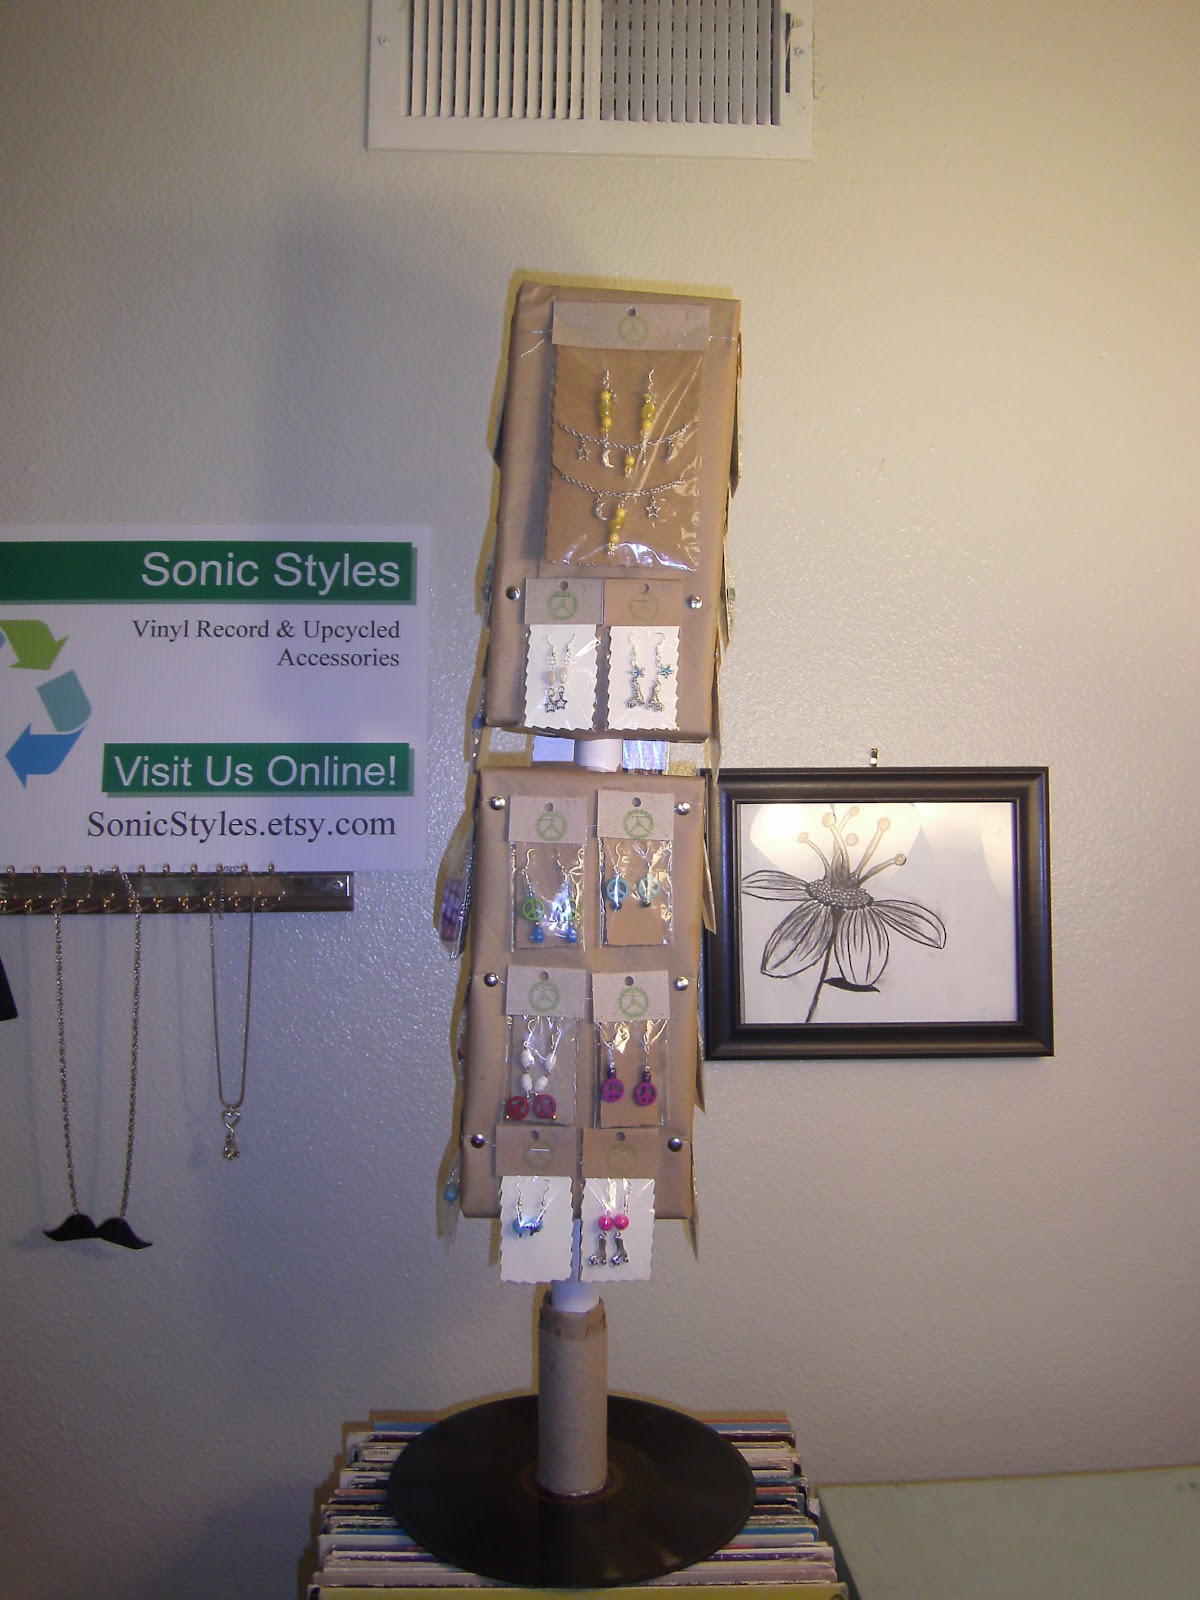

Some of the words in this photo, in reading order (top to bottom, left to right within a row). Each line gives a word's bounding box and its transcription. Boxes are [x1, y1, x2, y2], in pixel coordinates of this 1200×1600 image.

[141, 551, 259, 587] Sonic
[273, 552, 401, 596] Styles
[132, 620, 189, 642] Vinyl
[196, 620, 270, 639] Record
[276, 620, 296, 639] &
[303, 620, 401, 643] Upcycled
[277, 648, 401, 668] Accessories
[114, 755, 193, 787] Visit
[205, 755, 254, 786] Us
[267, 755, 397, 786] Online!
[87, 810, 397, 843] SonicStyles.etsy.com
